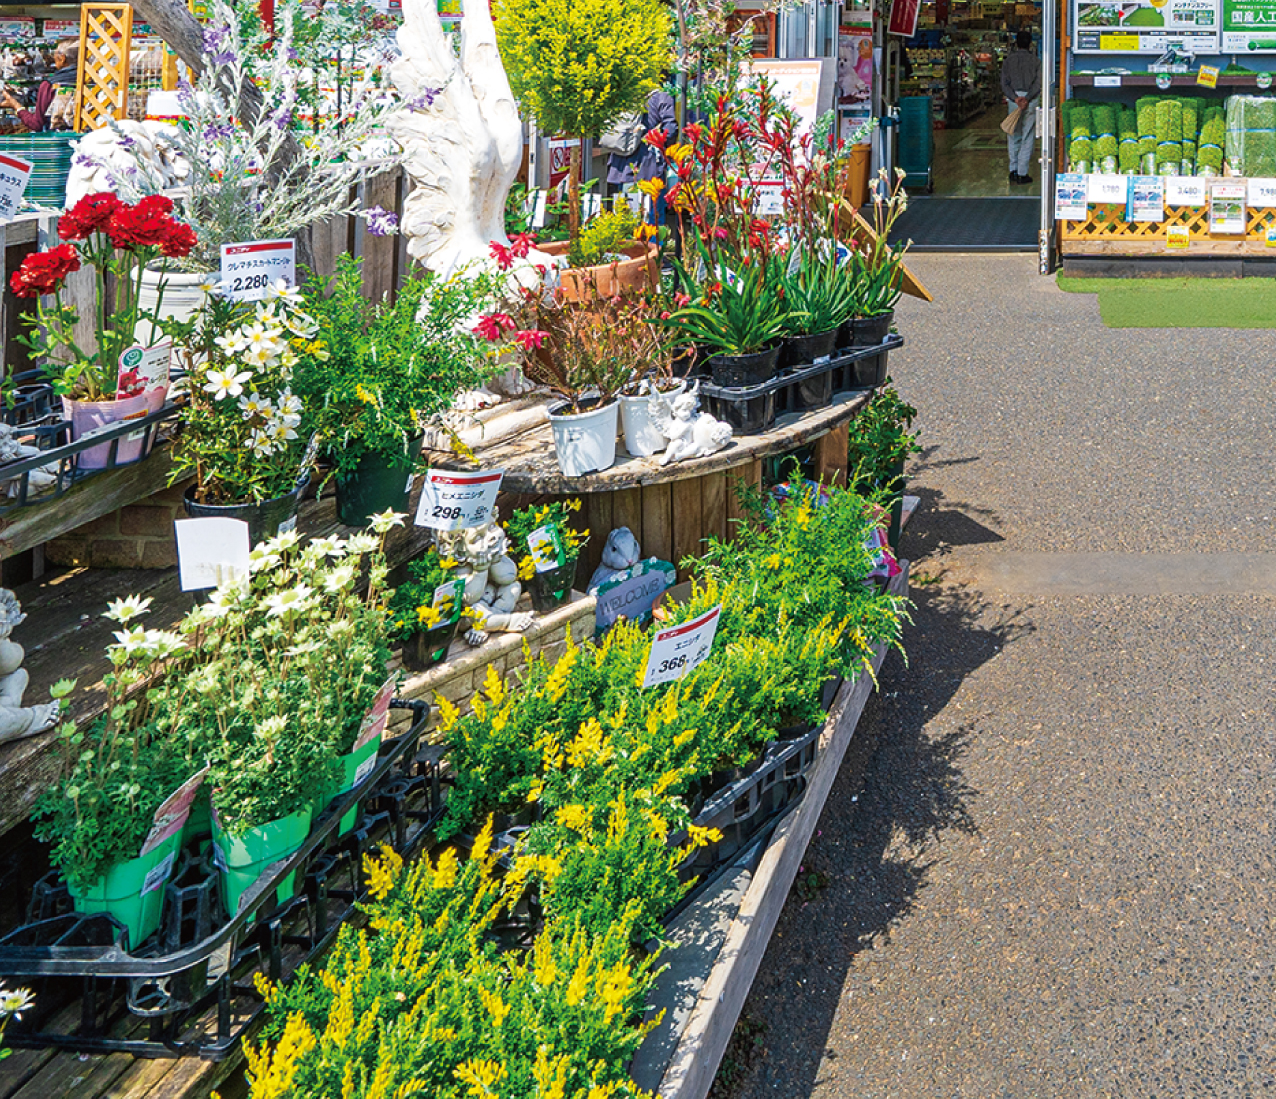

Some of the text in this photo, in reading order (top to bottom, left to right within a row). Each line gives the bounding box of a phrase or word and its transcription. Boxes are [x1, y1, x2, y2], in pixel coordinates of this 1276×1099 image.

[432, 505, 462, 520] 298
[600, 578, 660, 616] WELCOME
[658, 654, 687, 674] 368
